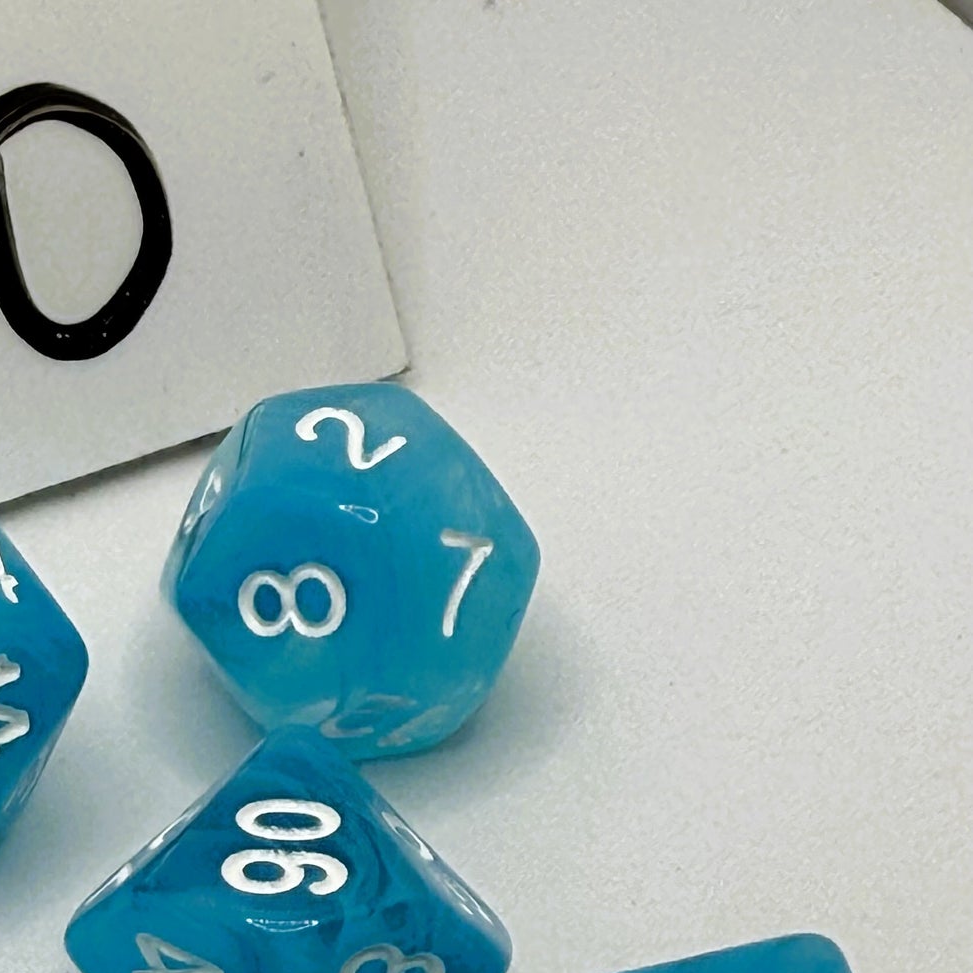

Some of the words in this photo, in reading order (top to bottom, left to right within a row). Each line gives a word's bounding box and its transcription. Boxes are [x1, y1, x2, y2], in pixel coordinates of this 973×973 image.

[295, 407, 407, 471] 2
[238, 562, 347, 638] 8
[440, 528, 494, 638] 7
[221, 798, 348, 895] 90
